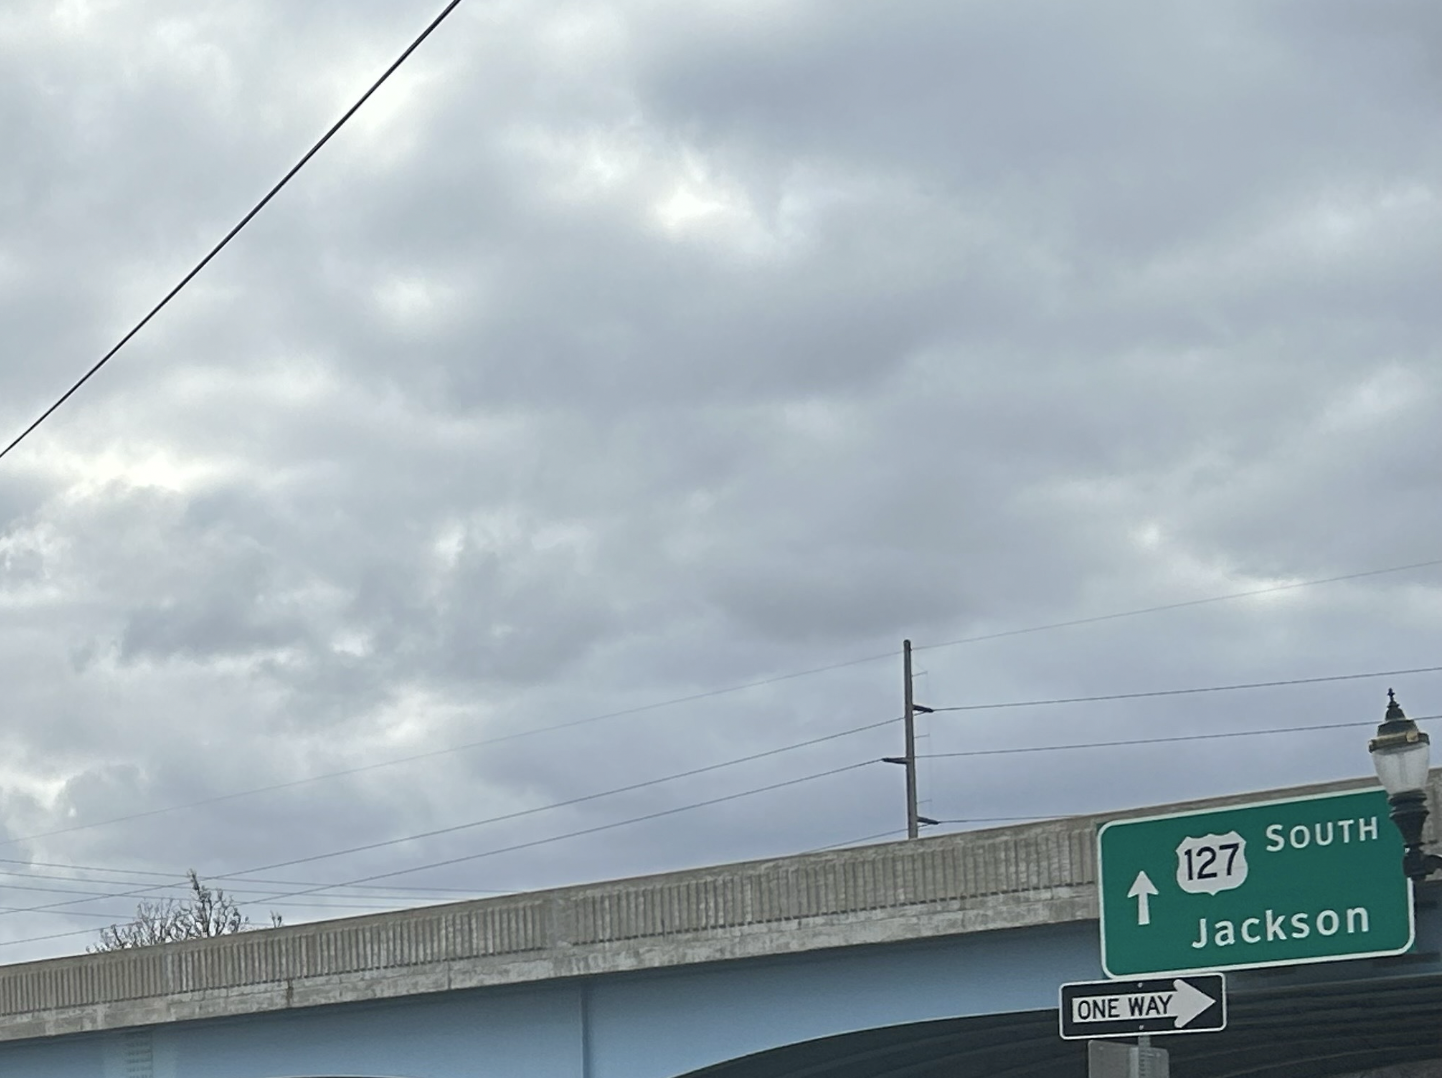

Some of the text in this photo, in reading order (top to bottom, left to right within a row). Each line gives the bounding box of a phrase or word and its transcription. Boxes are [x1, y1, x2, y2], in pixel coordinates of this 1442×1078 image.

[1183, 816, 1379, 881] 127 SOUTH
[1191, 906, 1370, 950] Jackson
[1077, 994, 1173, 1020] ONE WAY
